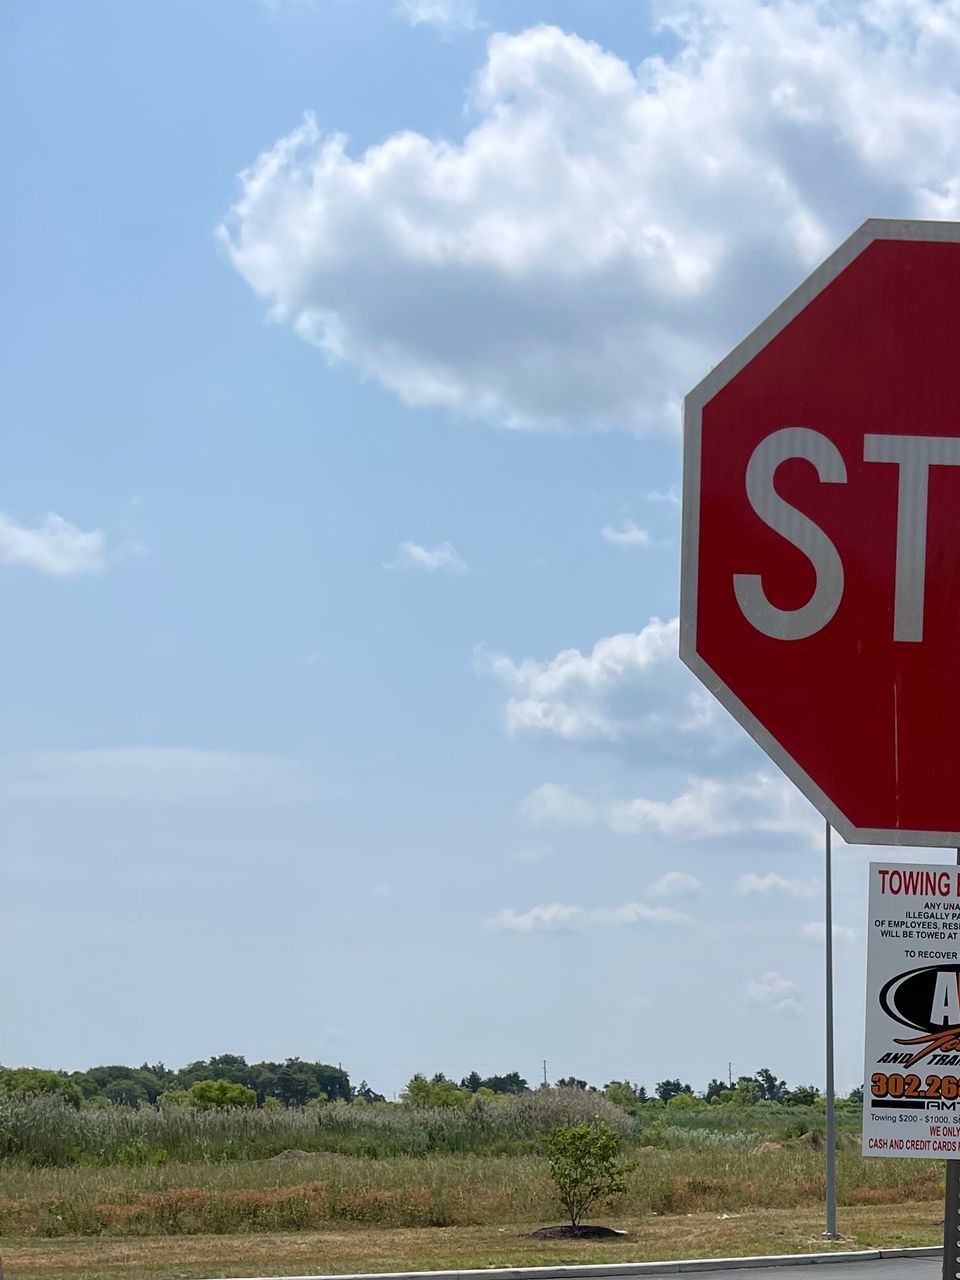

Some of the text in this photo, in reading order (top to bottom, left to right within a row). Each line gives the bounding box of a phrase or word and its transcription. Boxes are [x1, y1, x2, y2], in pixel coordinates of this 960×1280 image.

[878, 870, 950, 897] TOWING
[905, 912, 950, 920] ILLEGALLY
[888, 921, 940, 930] EMPLOYEES,
[881, 930, 899, 938] WILL
[917, 931, 945, 939] TOWED
[947, 932, 958, 940] AT
[905, 950, 916, 958] TO
[918, 951, 958, 960] RECOVER
[876, 1052, 914, 1064] AND
[871, 1114, 896, 1123] Towing
[899, 1115, 917, 1123] $200
[930, 1126, 941, 1136] WE
[943, 1126, 960, 1137] ONLY
[869, 1138, 888, 1149] CASH
[889, 1139, 904, 1150] AND
[906, 1140, 931, 1150] CREDIT
[933, 1141, 957, 1151] CARDS
